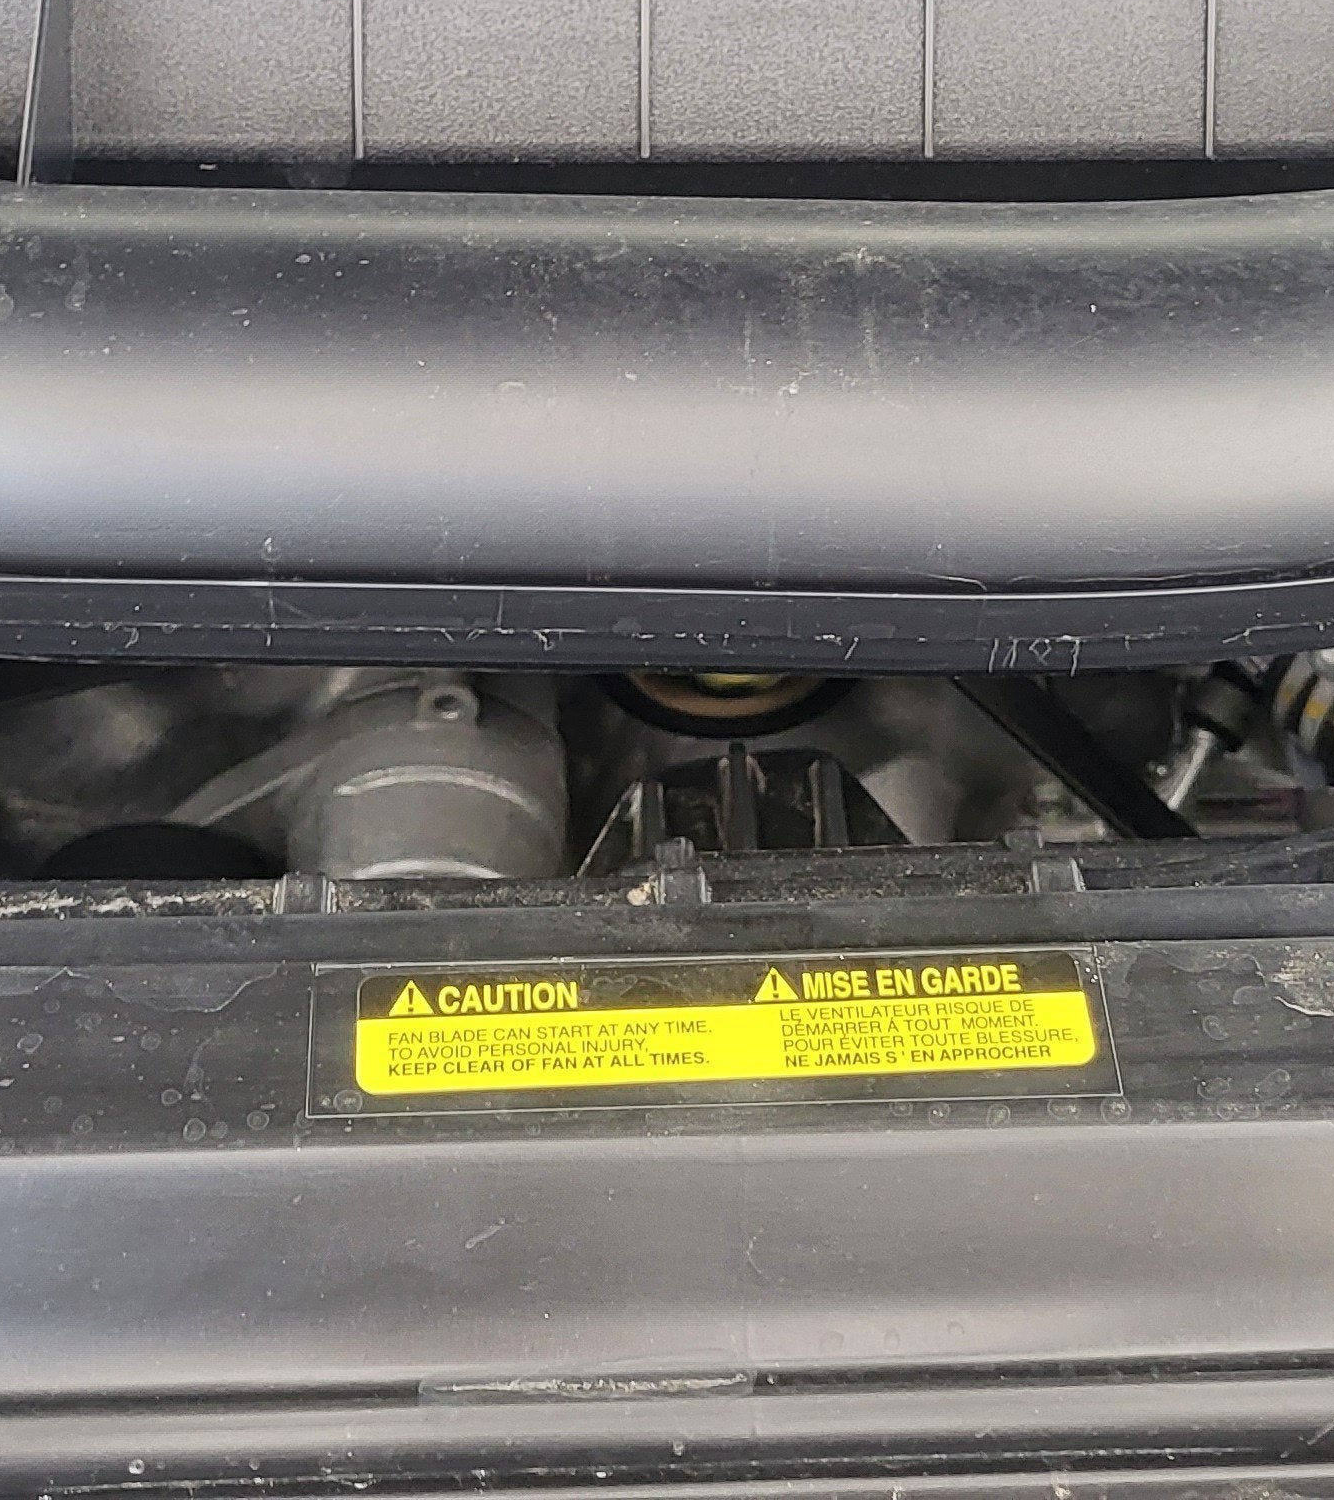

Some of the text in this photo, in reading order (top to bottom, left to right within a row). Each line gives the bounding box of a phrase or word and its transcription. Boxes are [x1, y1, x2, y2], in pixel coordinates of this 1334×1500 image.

[802, 964, 1022, 999] MISE EN GARDE
[438, 981, 578, 1014] CAUTION
[780, 999, 1034, 1021] LE VENTILATEUR RISQUE DE
[389, 1020, 712, 1045] FAN BLADE CAN START AT ANY TIME.
[782, 1019, 882, 1037] DÉMARRER
[905, 1018, 951, 1031] TOUT
[962, 1014, 1038, 1029] MOMENT.
[389, 1038, 648, 1060] TO AVOID PERSONAL INJURY,
[784, 1028, 1079, 1052] POUR ÉVITER TOUTE BLESSURE,
[389, 1051, 710, 1076] KEEP CLEAR OF FAN AT ALL TIMES.
[786, 1055, 809, 1068] NE
[815, 1052, 880, 1066] JAMAIS
[940, 1045, 1051, 1061] APPROCHER
